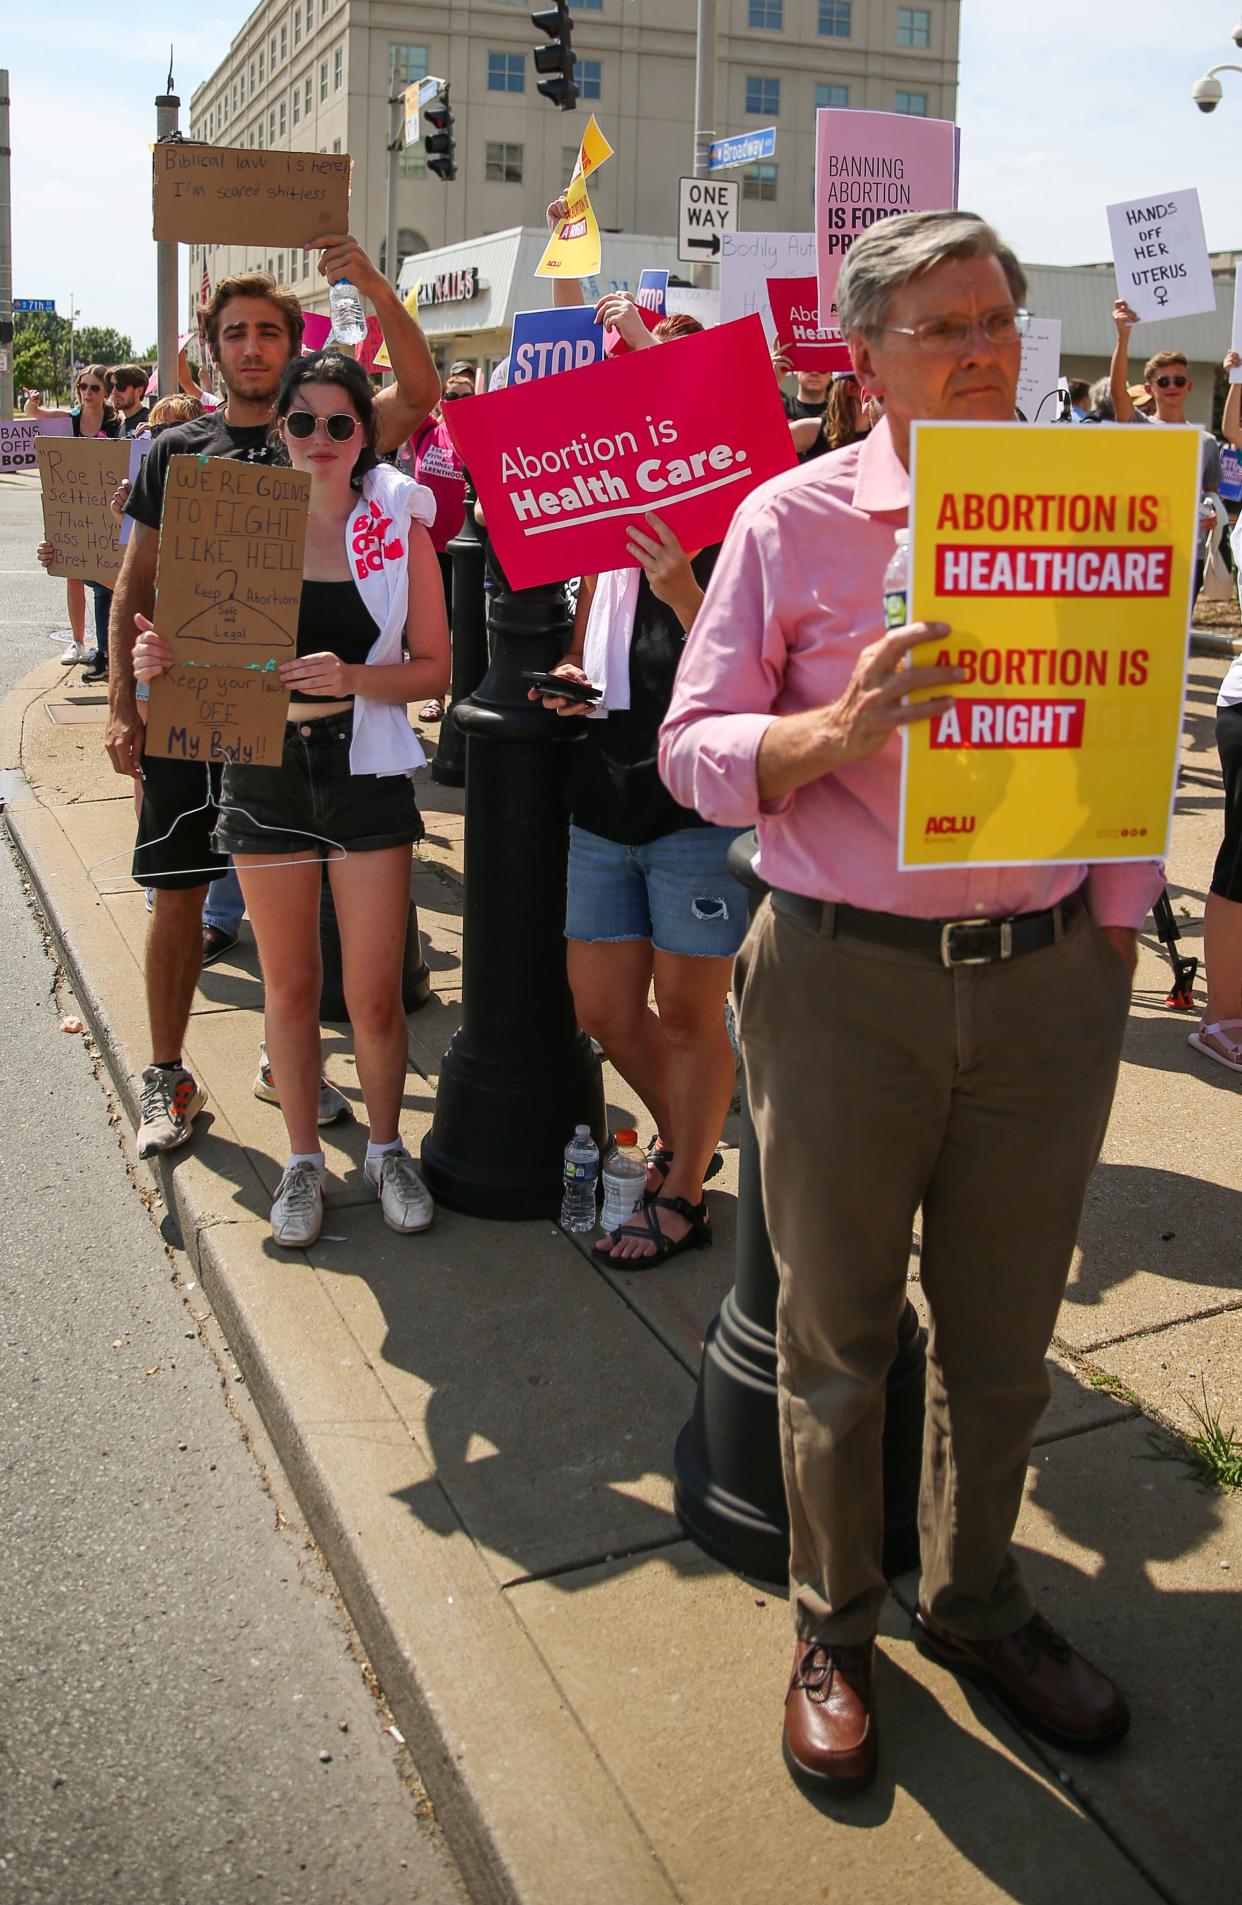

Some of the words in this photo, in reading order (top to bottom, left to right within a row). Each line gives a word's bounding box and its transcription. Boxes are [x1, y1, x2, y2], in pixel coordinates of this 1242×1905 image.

[165, 149, 225, 170] Biblical
[236, 155, 267, 170] law
[287, 156, 305, 172] is
[723, 138, 764, 162] Broadway
[829, 156, 904, 179] BANNING
[173, 182, 206, 198] I'm
[217, 182, 259, 200] scared
[268, 184, 327, 201] shitless
[690, 185, 728, 205] ONE
[828, 181, 911, 204] ABORTION
[688, 207, 729, 228] WAY
[828, 208, 846, 230] IS
[1126, 202, 1178, 226] HANDS
[1138, 227, 1162, 241] OFF
[722, 235, 778, 270] Bodily
[1134, 243, 1169, 260] HER
[434, 268, 474, 304] NAILS
[1132, 263, 1187, 286] UTERUS
[28, 300, 44, 310] 7th
[639, 288, 664, 313] STOP
[514, 340, 596, 385] STOP
[1, 426, 39, 438] BANS
[2, 441, 31, 452] OFF
[501, 433, 638, 484] Abortion
[645, 415, 678, 447] is
[2, 454, 36, 466] BOD
[99, 463, 118, 486] is
[509, 470, 631, 521] Health
[636, 444, 747, 493] Care.
[48, 488, 107, 507] settled
[257, 475, 310, 502] GOING
[171, 497, 202, 524] TO
[215, 500, 300, 537] FIGHT
[936, 493, 1116, 533] ABORTION
[1127, 495, 1159, 533] IS
[54, 533, 79, 547] ass
[54, 549, 88, 567] Bret
[175, 536, 233, 563] LIKE
[247, 541, 301, 571] HELL
[943, 551, 1166, 592] HEALTHCARE
[194, 582, 221, 602] Keep
[215, 624, 246, 640] Legal
[1118, 649, 1150, 686] IS
[218, 677, 255, 697] your
[199, 700, 237, 722] OFF
[937, 706, 961, 744] A
[971, 705, 1077, 744] RIGHT
[168, 726, 200, 758] My
[925, 816, 975, 834] ACLU
